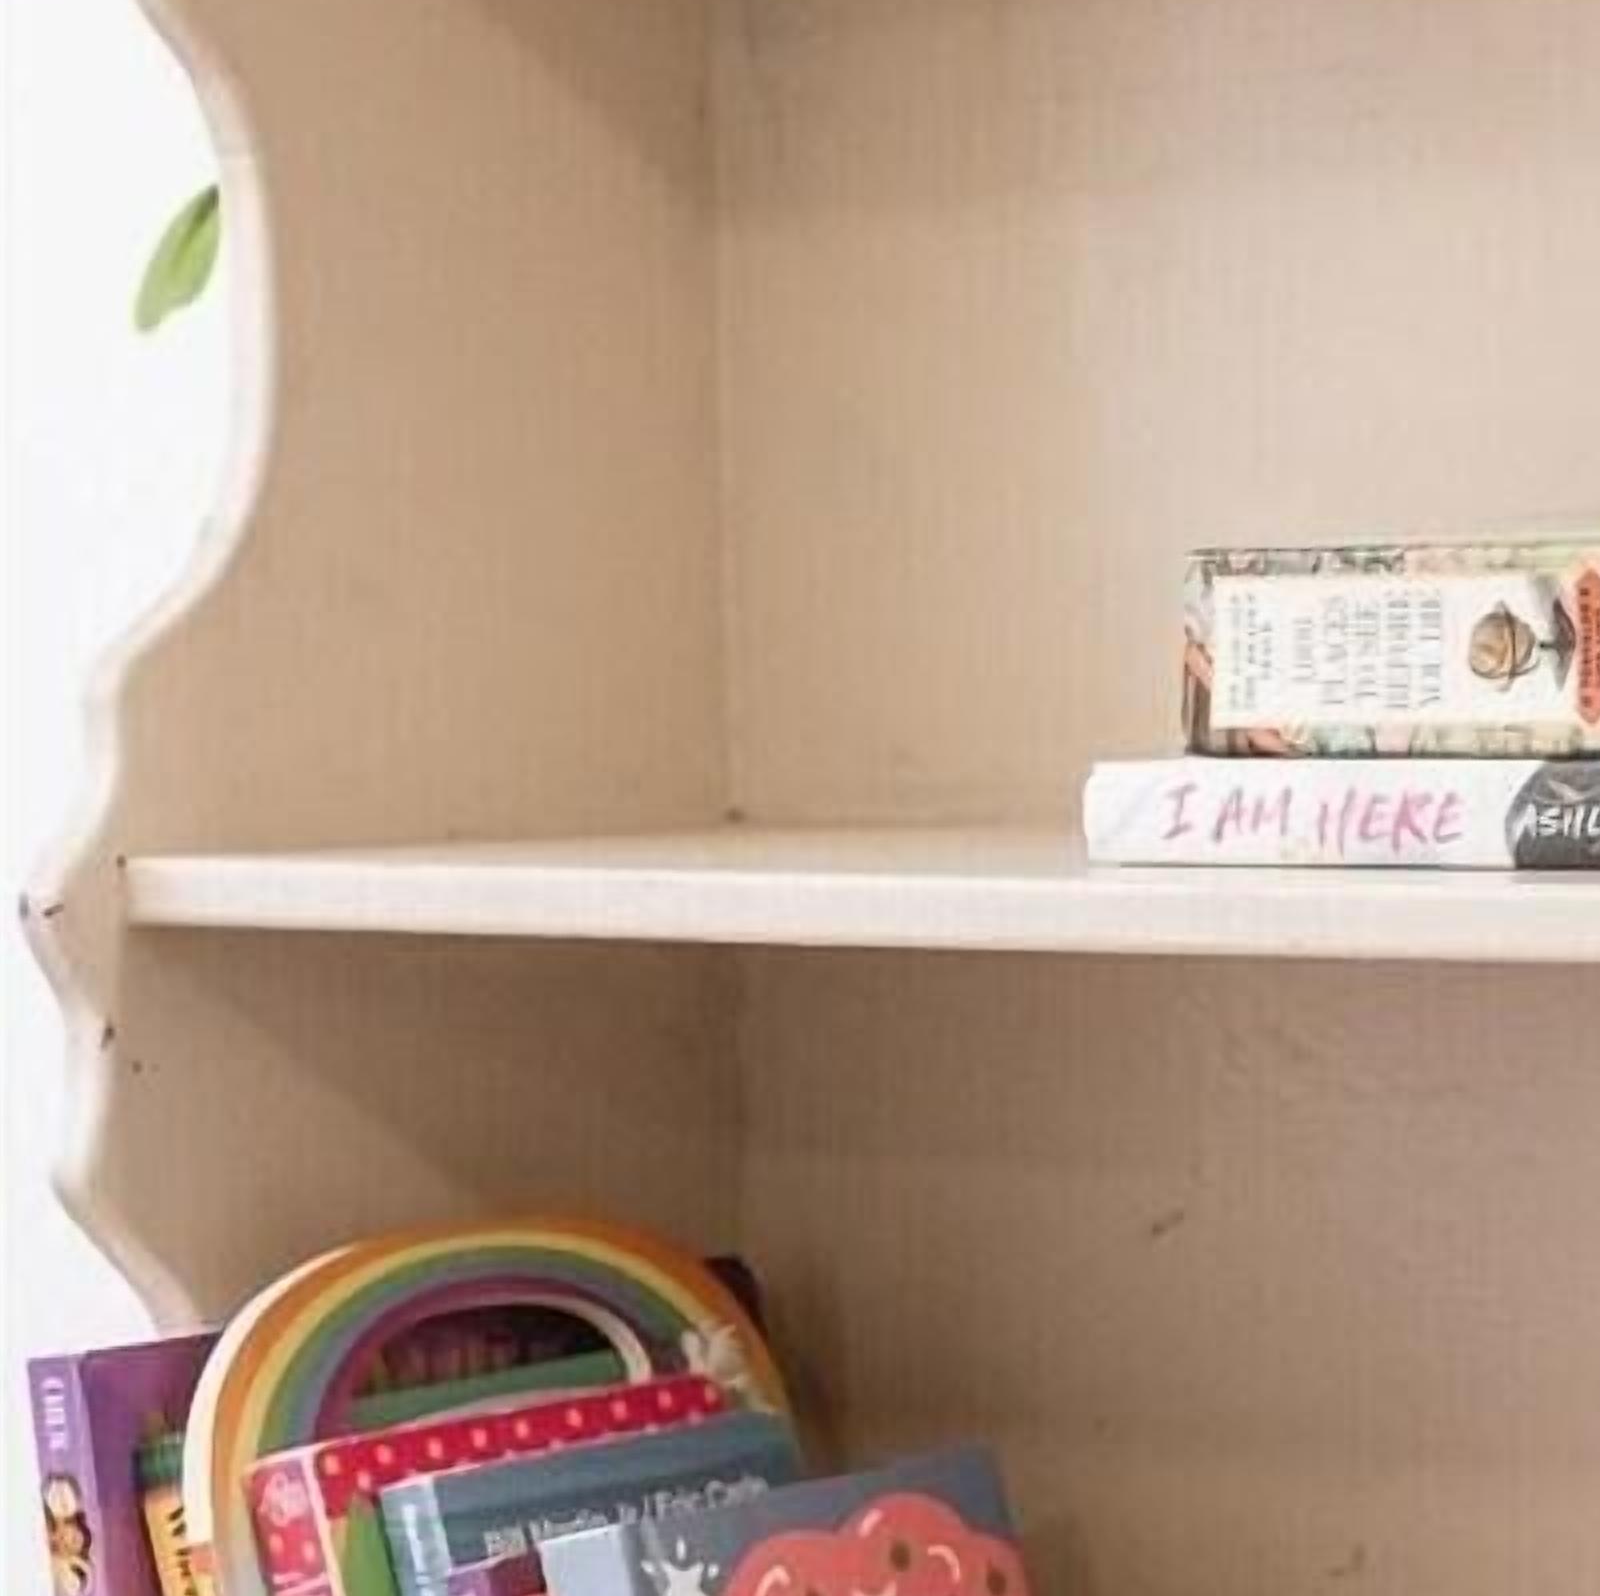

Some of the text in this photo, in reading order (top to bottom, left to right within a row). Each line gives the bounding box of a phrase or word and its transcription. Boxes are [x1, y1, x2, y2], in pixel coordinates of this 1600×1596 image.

[1160, 783, 1468, 855] I AM HERE
